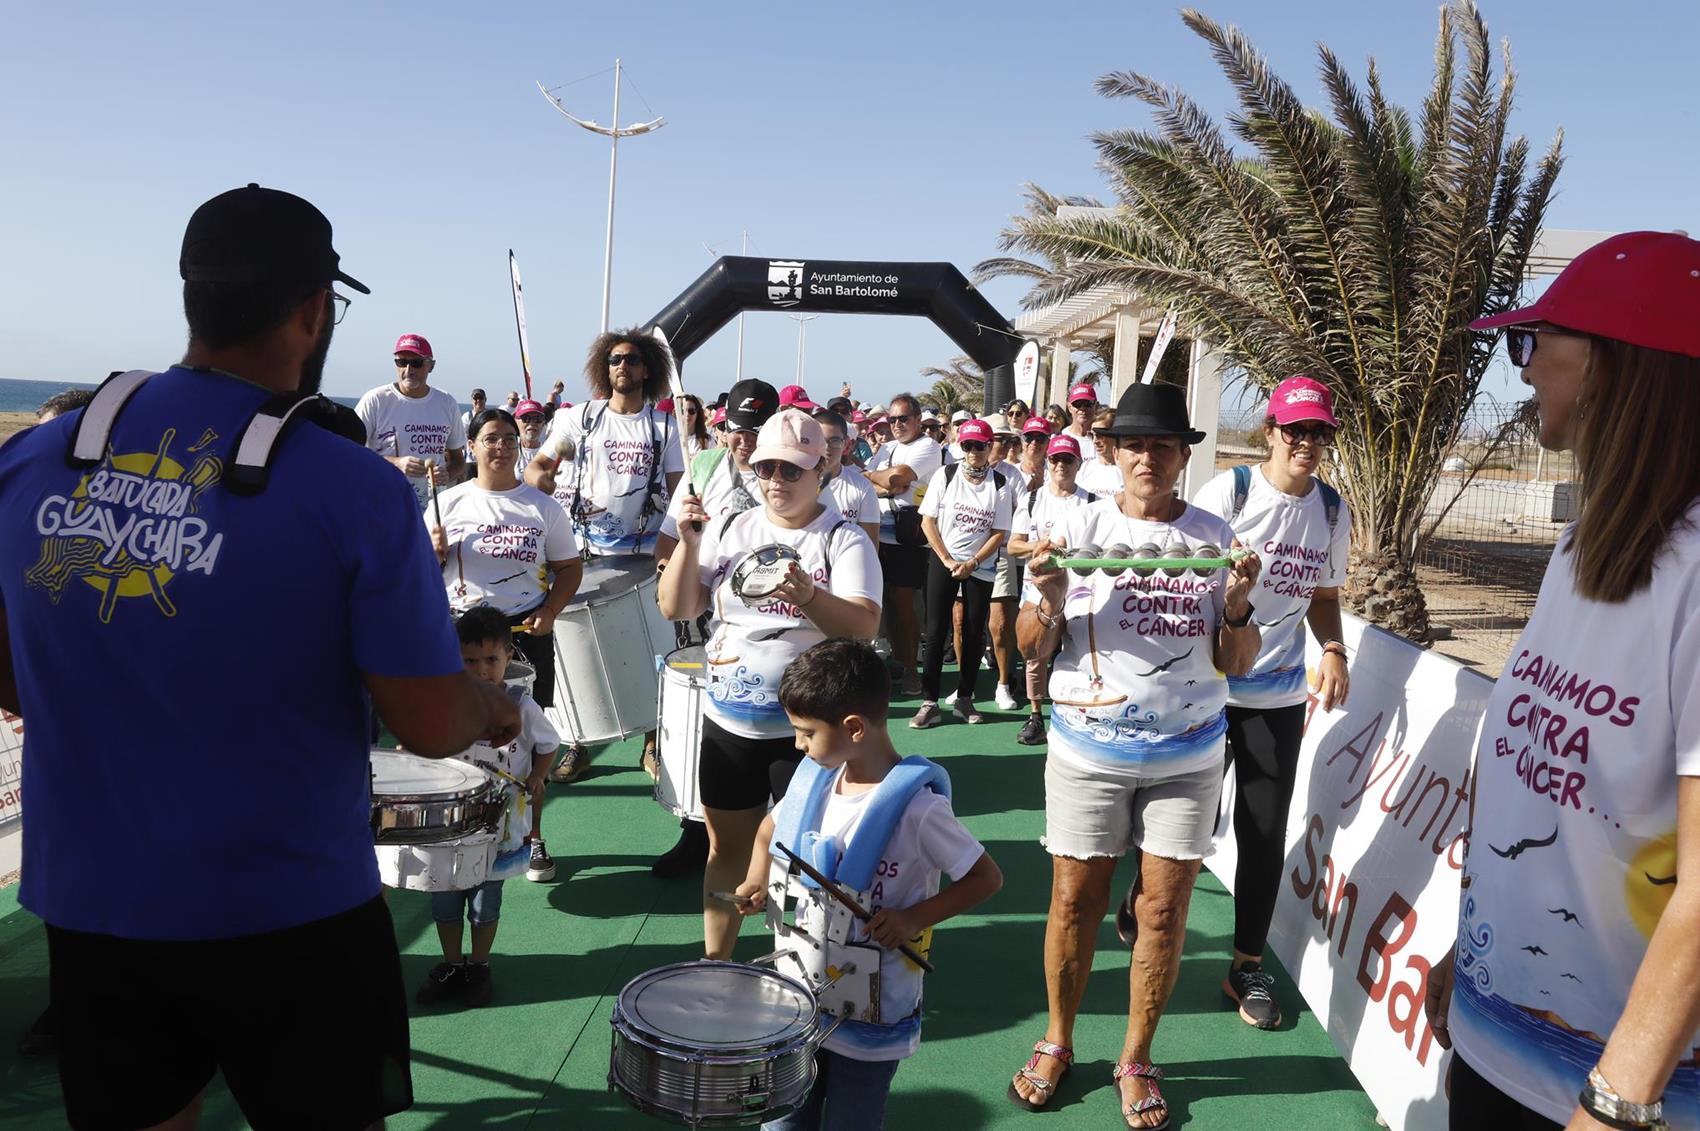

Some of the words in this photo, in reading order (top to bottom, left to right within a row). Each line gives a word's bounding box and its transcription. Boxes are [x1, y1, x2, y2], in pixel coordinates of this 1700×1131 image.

[810, 271, 883, 284] Ayuntamiento
[884, 274, 899, 284] de
[810, 284, 833, 295] San
[835, 285, 899, 297] Bartolomé
[87, 470, 193, 517] BATUCADA
[477, 524, 544, 537] CAMINAMOS
[482, 535, 538, 550] CONTRA
[1114, 575, 1219, 594] CAMINAMOS
[1263, 580, 1274, 589] EL
[1122, 595, 1202, 615] CONTRA
[1119, 618, 1134, 631] EL
[1495, 737, 1516, 758] EL
[1290, 813, 1359, 960] San
